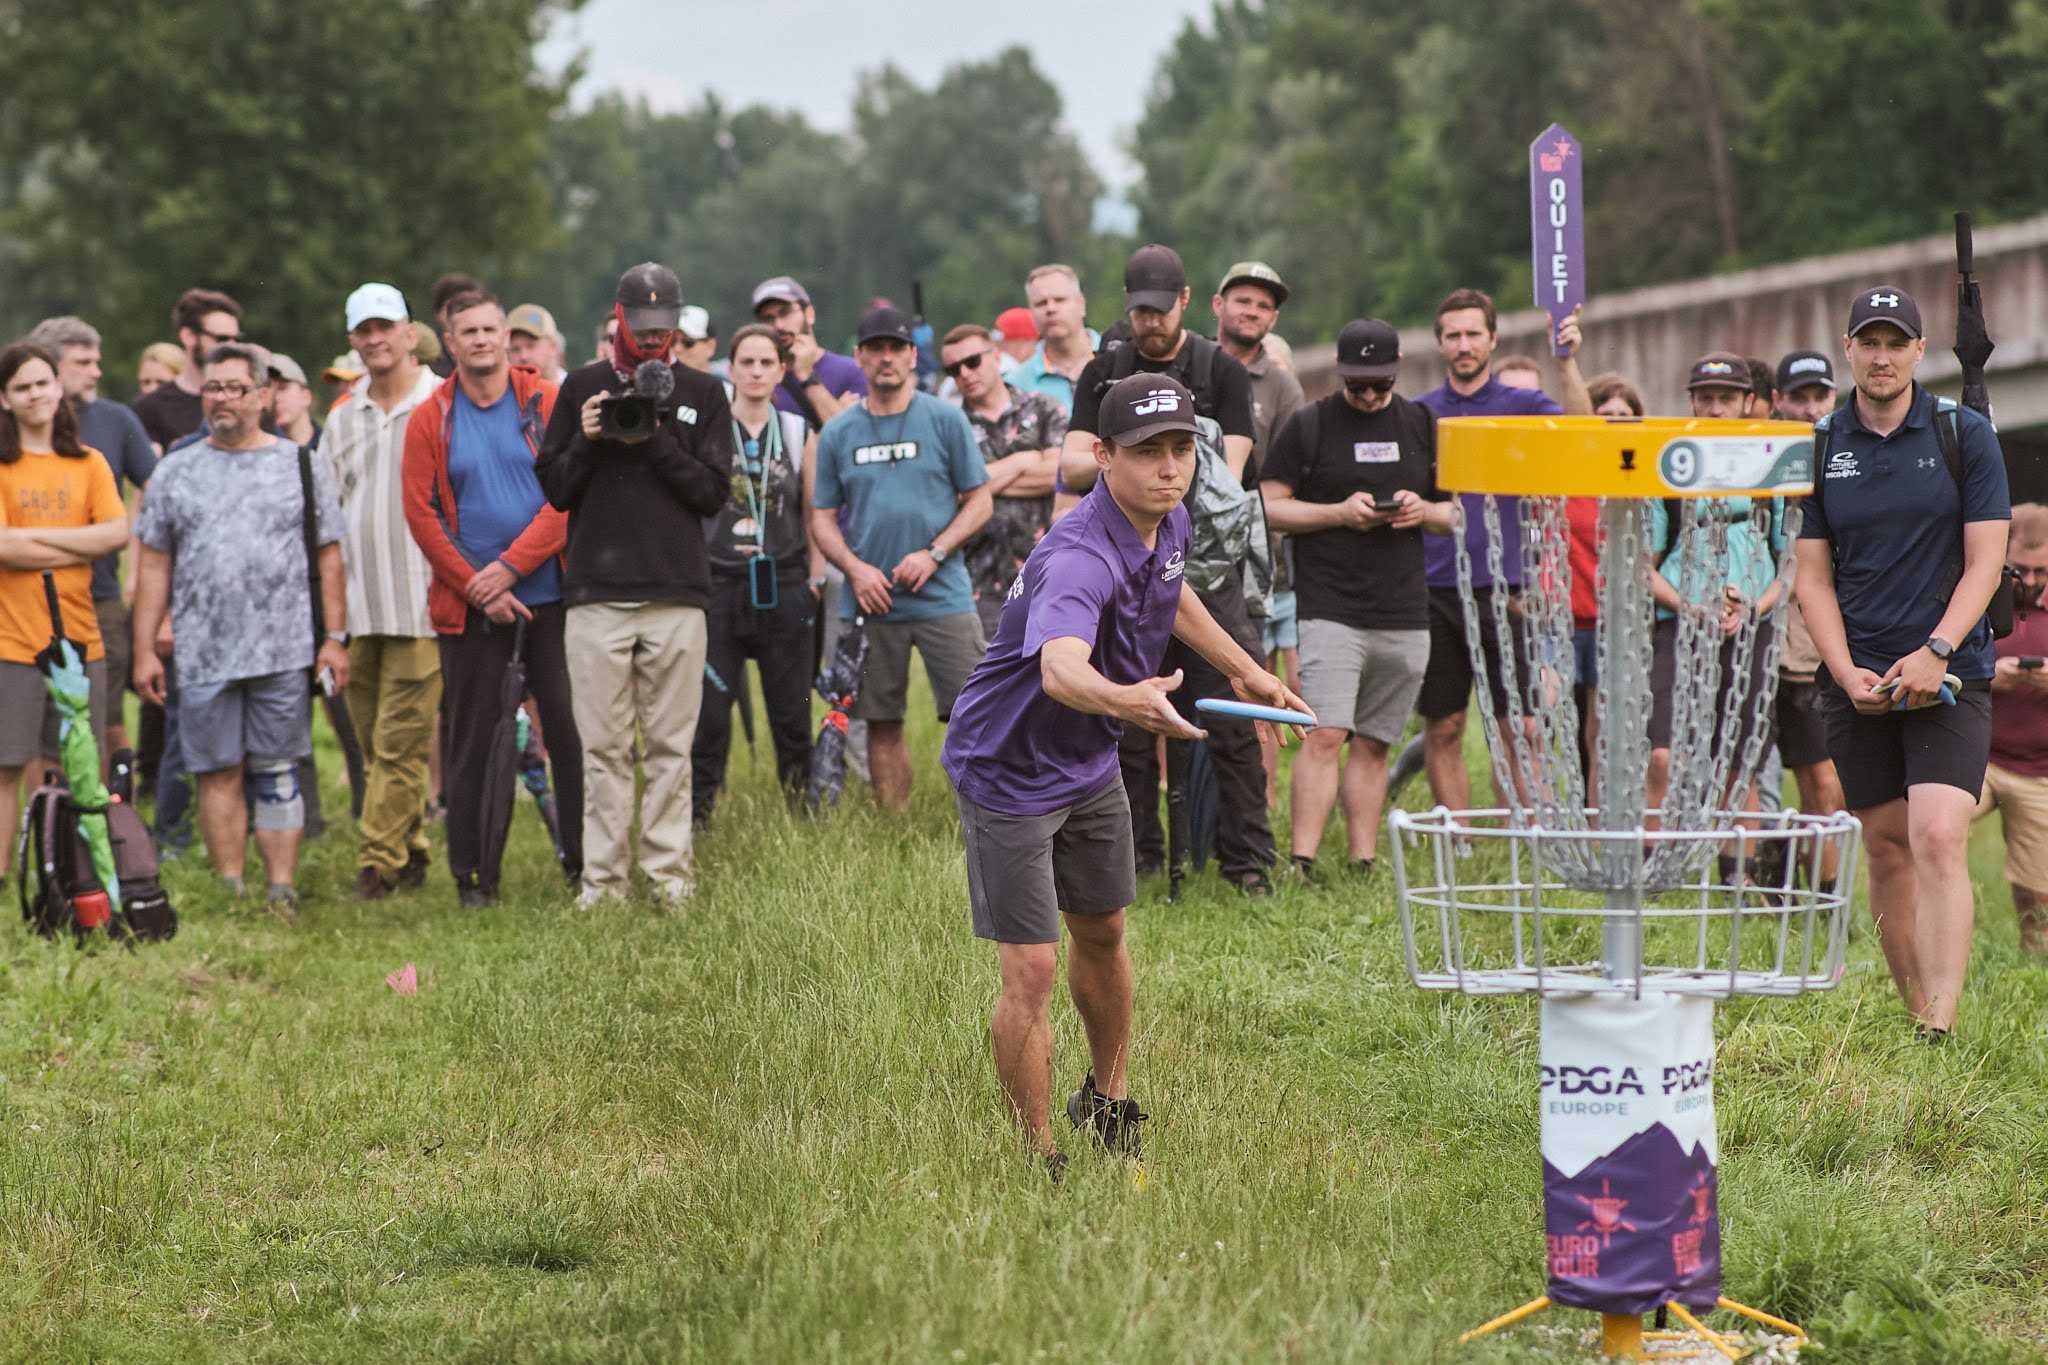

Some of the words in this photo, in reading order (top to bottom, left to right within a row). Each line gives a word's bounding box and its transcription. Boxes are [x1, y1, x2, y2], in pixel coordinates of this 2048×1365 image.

[1550, 178, 1568, 303] QUIET
[1671, 446, 1695, 483] 9
[1550, 1101, 1629, 1116] EUROPE
